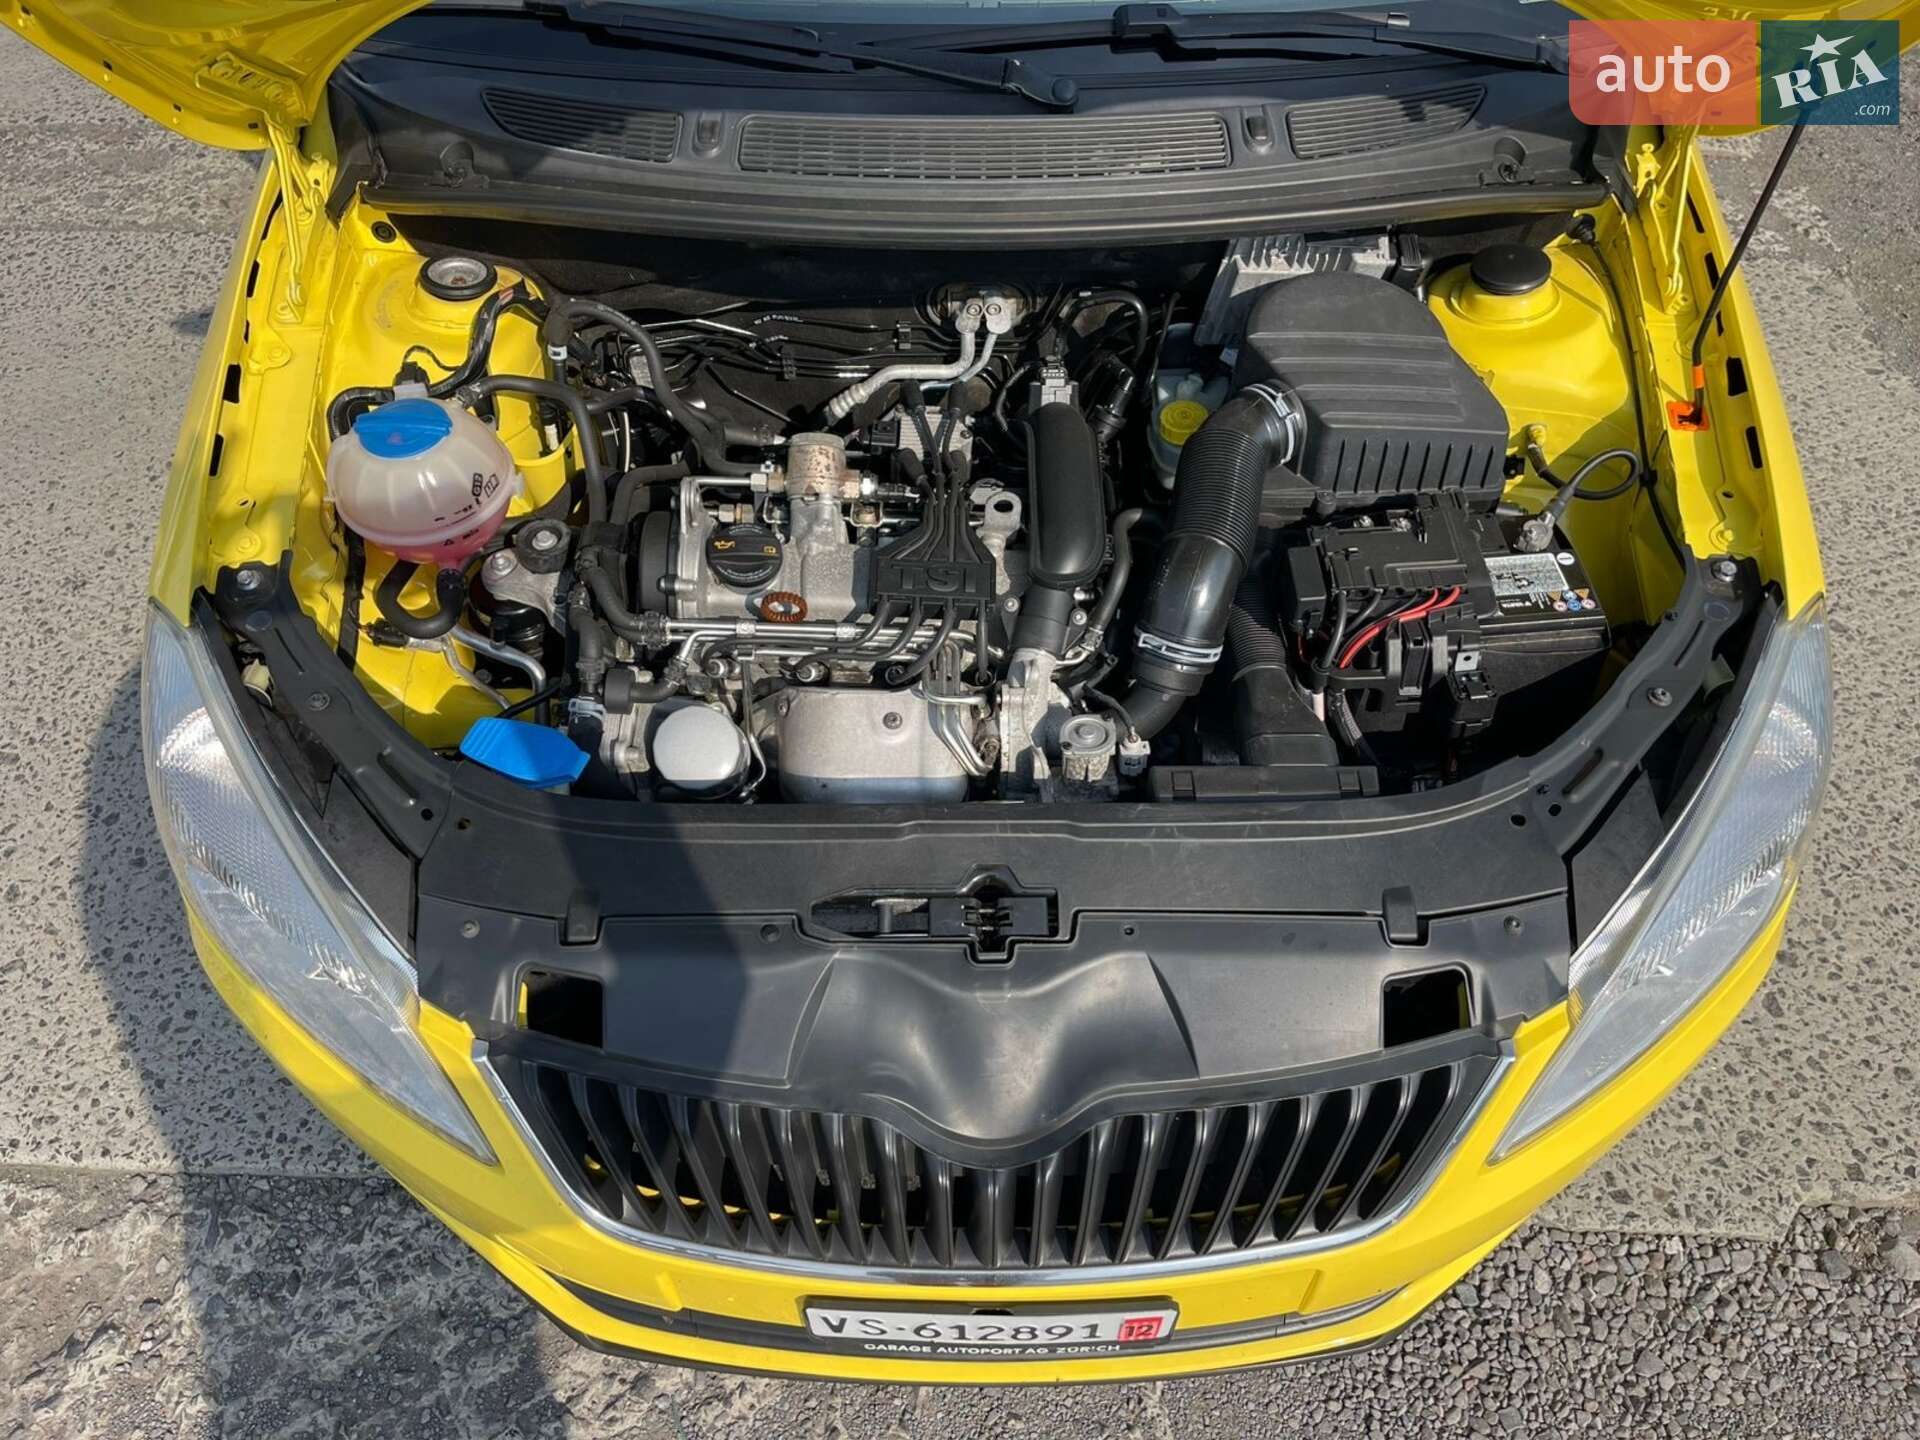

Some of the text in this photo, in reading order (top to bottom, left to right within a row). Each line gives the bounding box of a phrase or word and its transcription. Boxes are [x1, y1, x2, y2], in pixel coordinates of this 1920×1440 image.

[891, 564, 977, 593] TSI
[1126, 1324, 1154, 1337] 12
[863, 1343, 932, 1353] GARAGE
[936, 1346, 1023, 1355] AUTOPORT
[1024, 1347, 1049, 1355] AG
